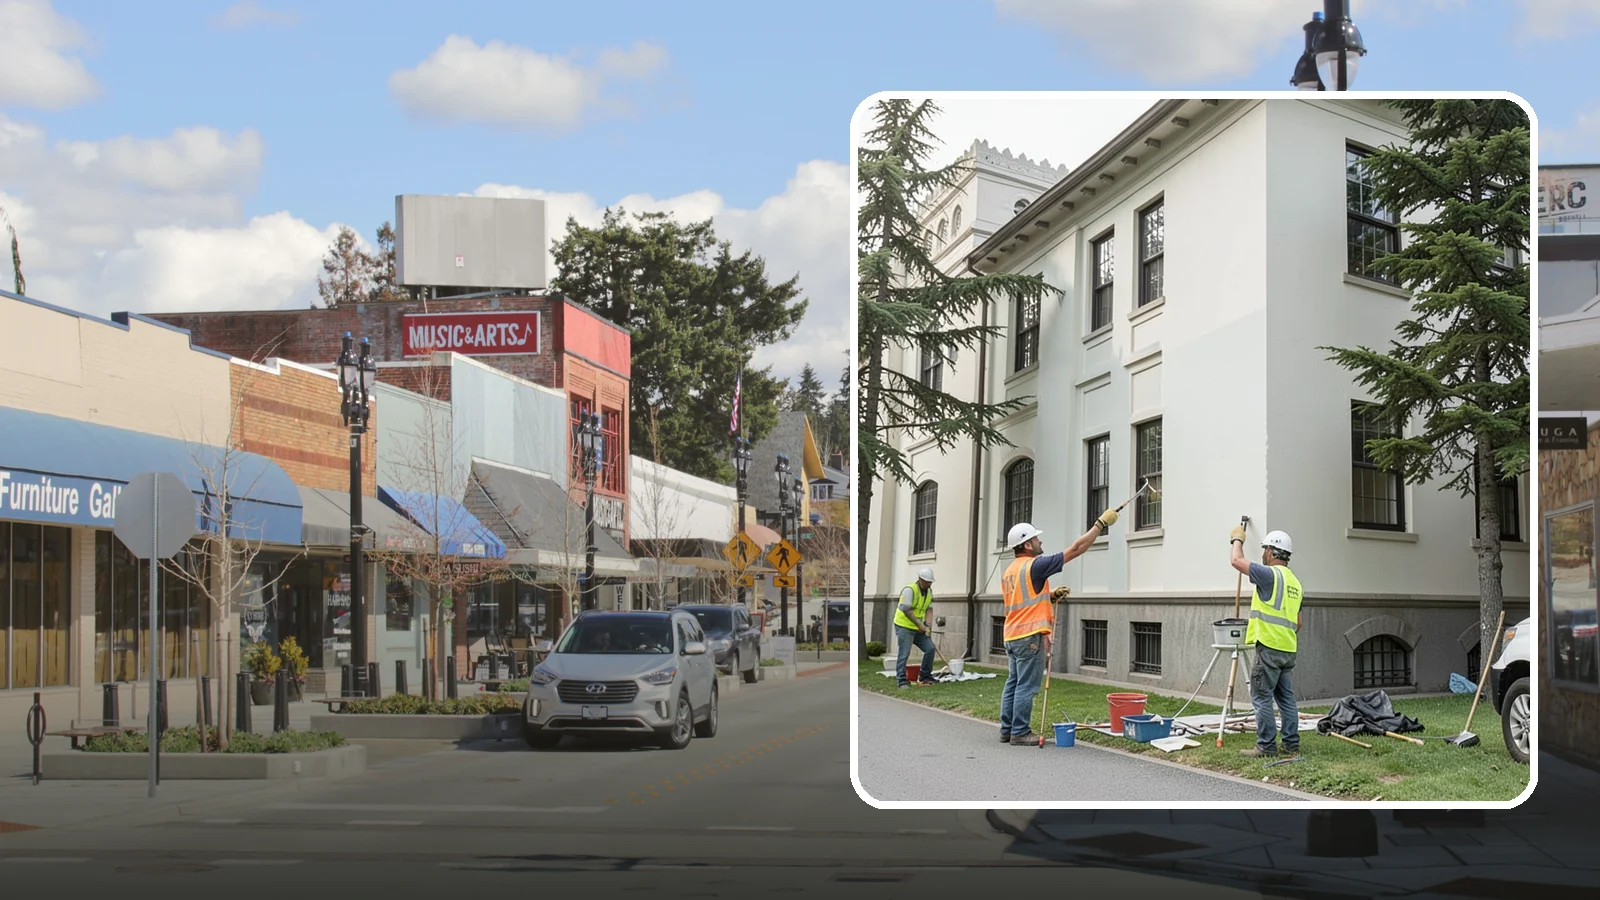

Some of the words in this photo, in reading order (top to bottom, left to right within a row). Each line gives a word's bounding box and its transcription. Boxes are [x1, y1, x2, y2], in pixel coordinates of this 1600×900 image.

[0, 471, 80, 516] Furniture
[89, 482, 122, 520] Gal
[453, 563, 479, 574] SUSHI
